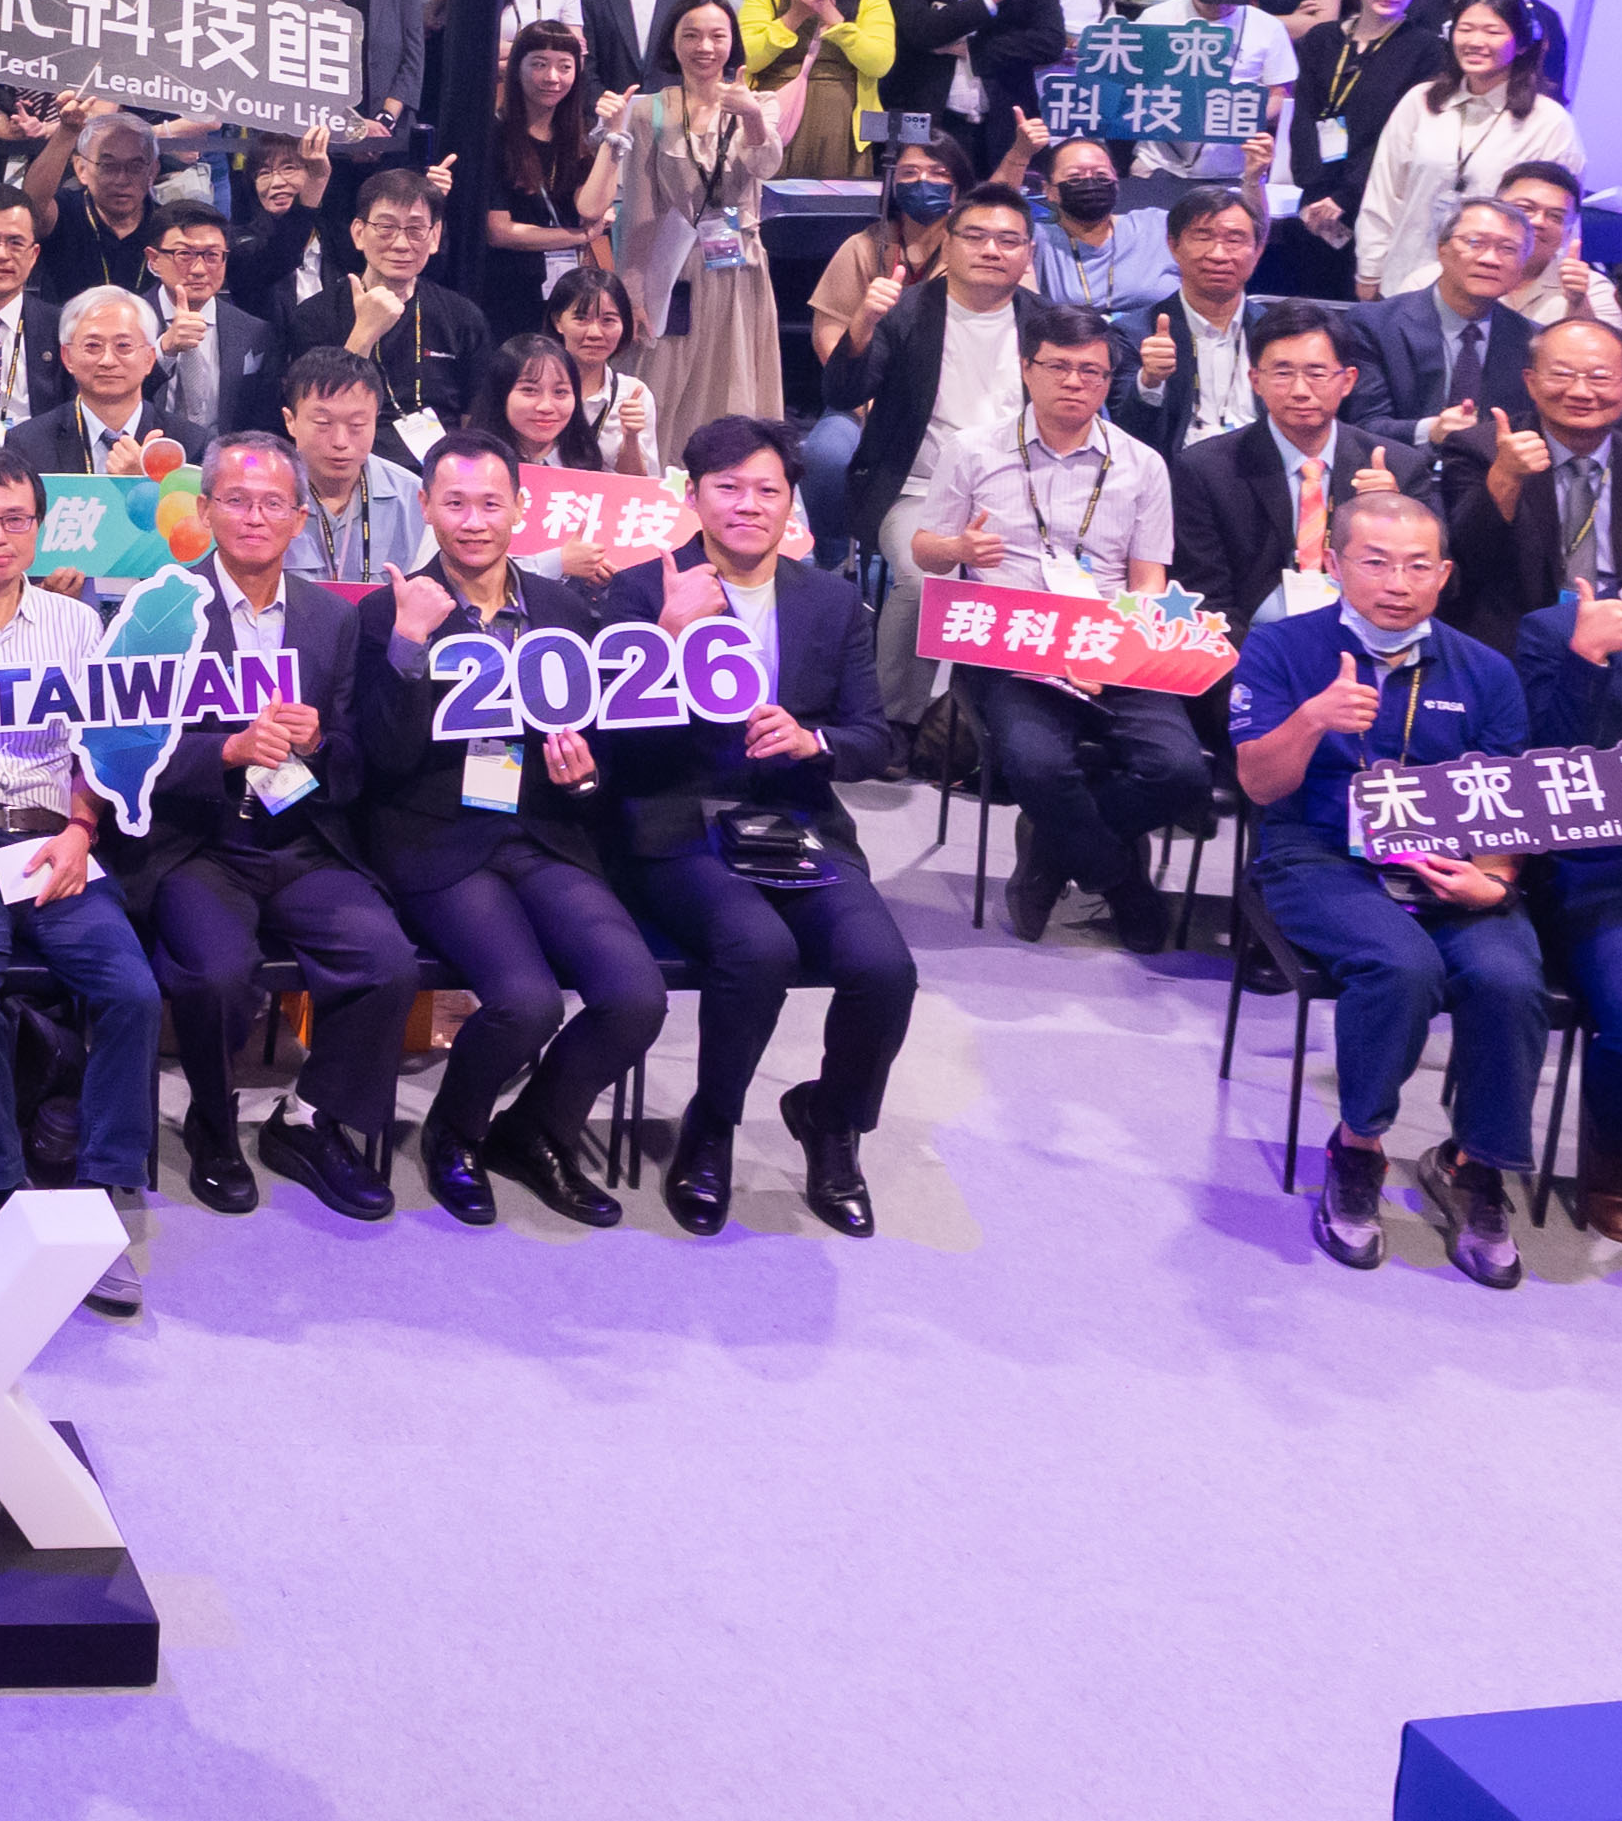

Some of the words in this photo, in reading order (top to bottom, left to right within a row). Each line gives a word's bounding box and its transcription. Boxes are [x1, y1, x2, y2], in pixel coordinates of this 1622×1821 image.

[1085, 20, 1236, 79] 未來
[93, 65, 208, 114] Leading
[215, 86, 285, 123] Your
[293, 104, 355, 136] Life.
[1046, 81, 1262, 139] 科技館
[943, 601, 1125, 665] 我科技
[431, 620, 769, 736] 2026
[1436, 700, 1467, 713] TASA
[1371, 830, 1458, 856] Future
